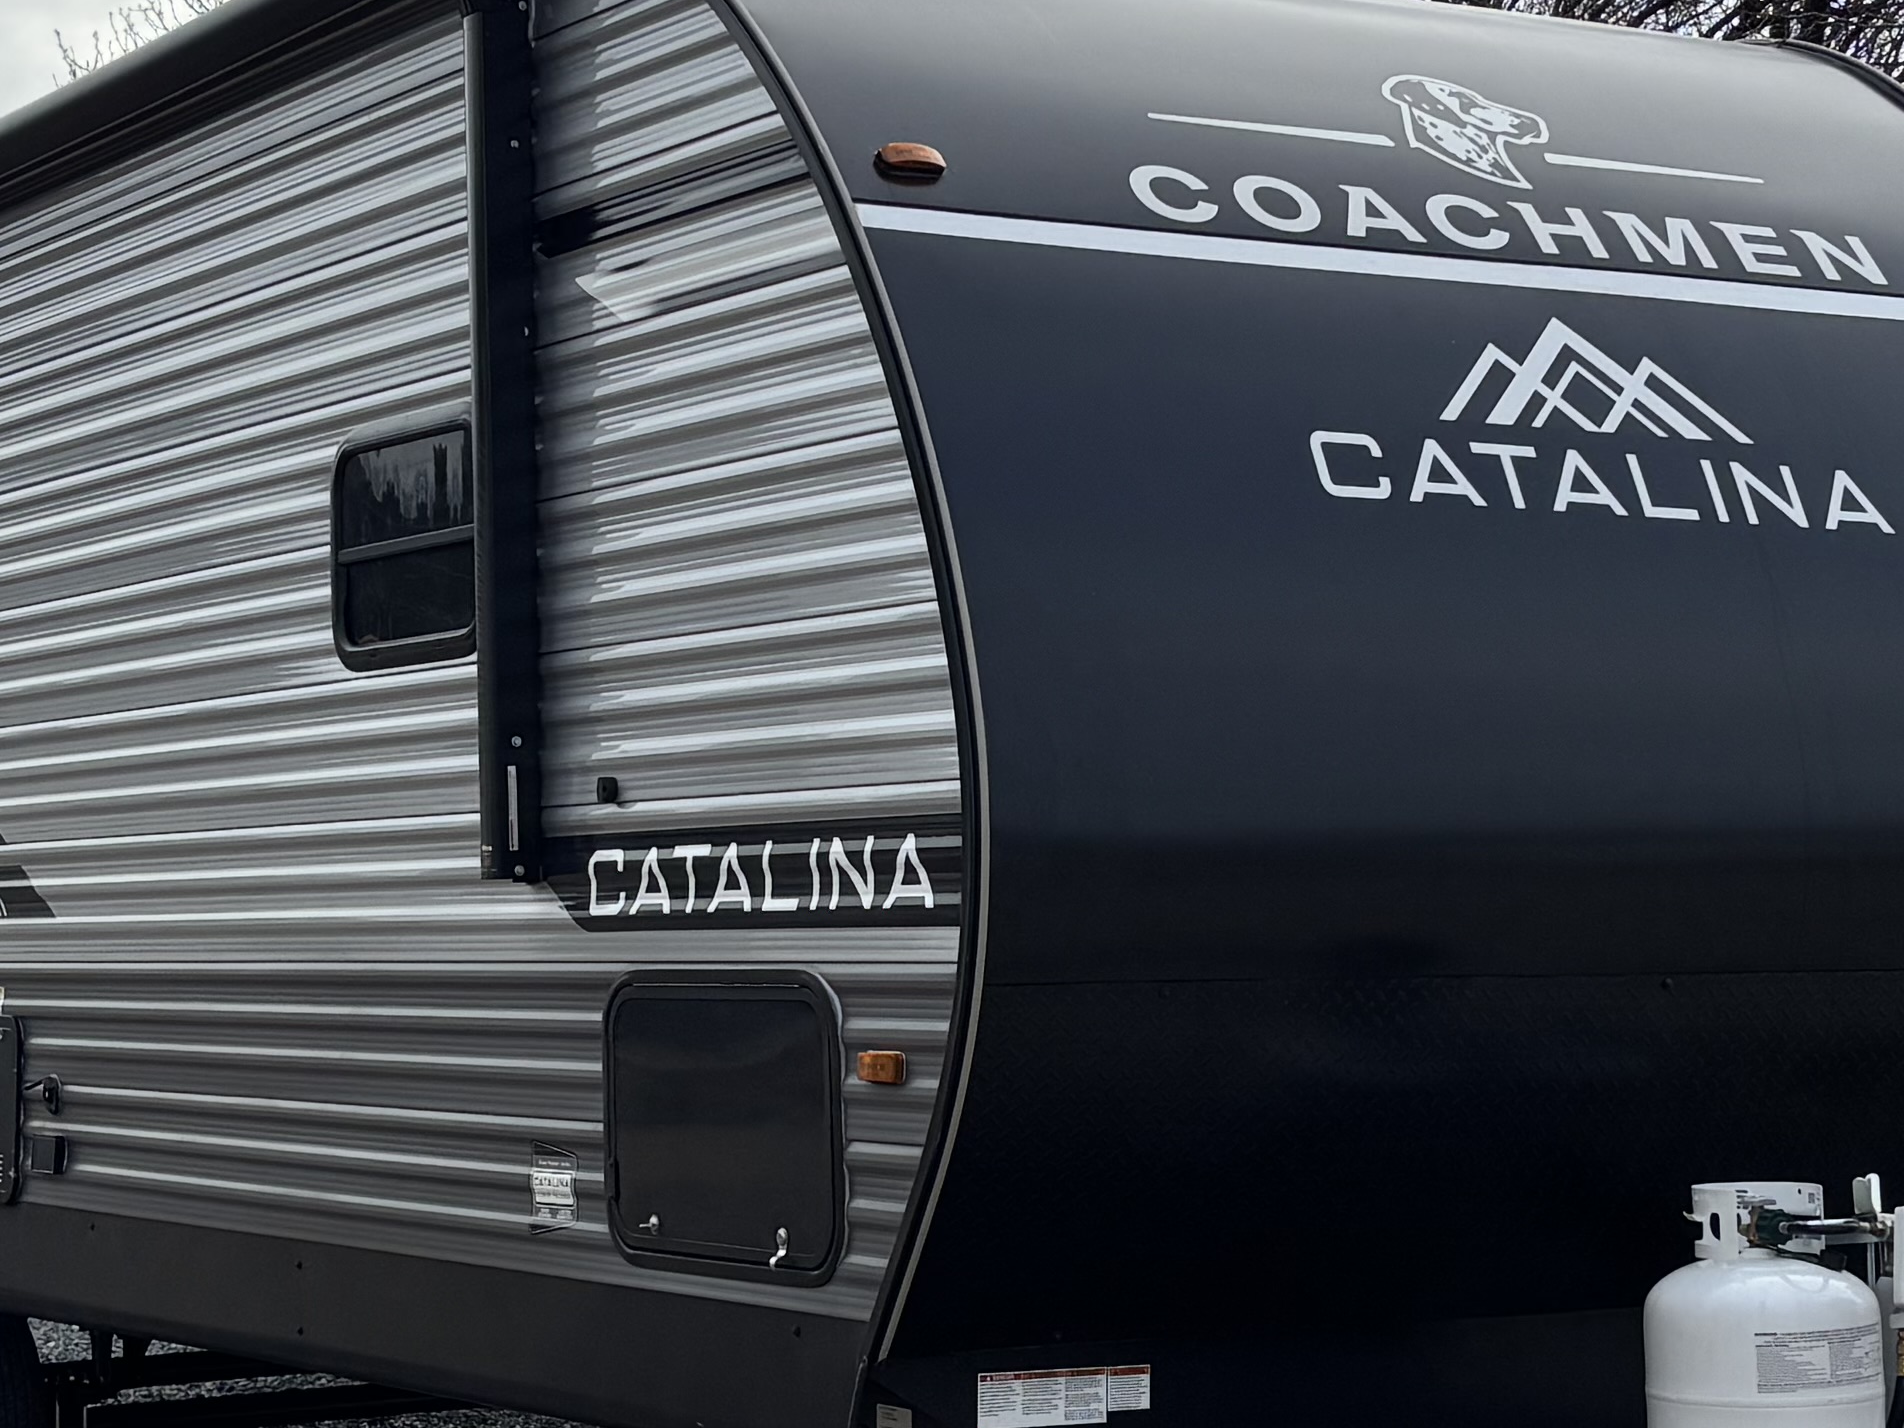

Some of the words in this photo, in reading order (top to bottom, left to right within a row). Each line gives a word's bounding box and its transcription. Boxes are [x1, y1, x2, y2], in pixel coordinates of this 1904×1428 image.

[1128, 164, 1889, 286] COACHMEN
[1309, 430, 1897, 534] CATALINA
[588, 832, 935, 916] CATALINA
